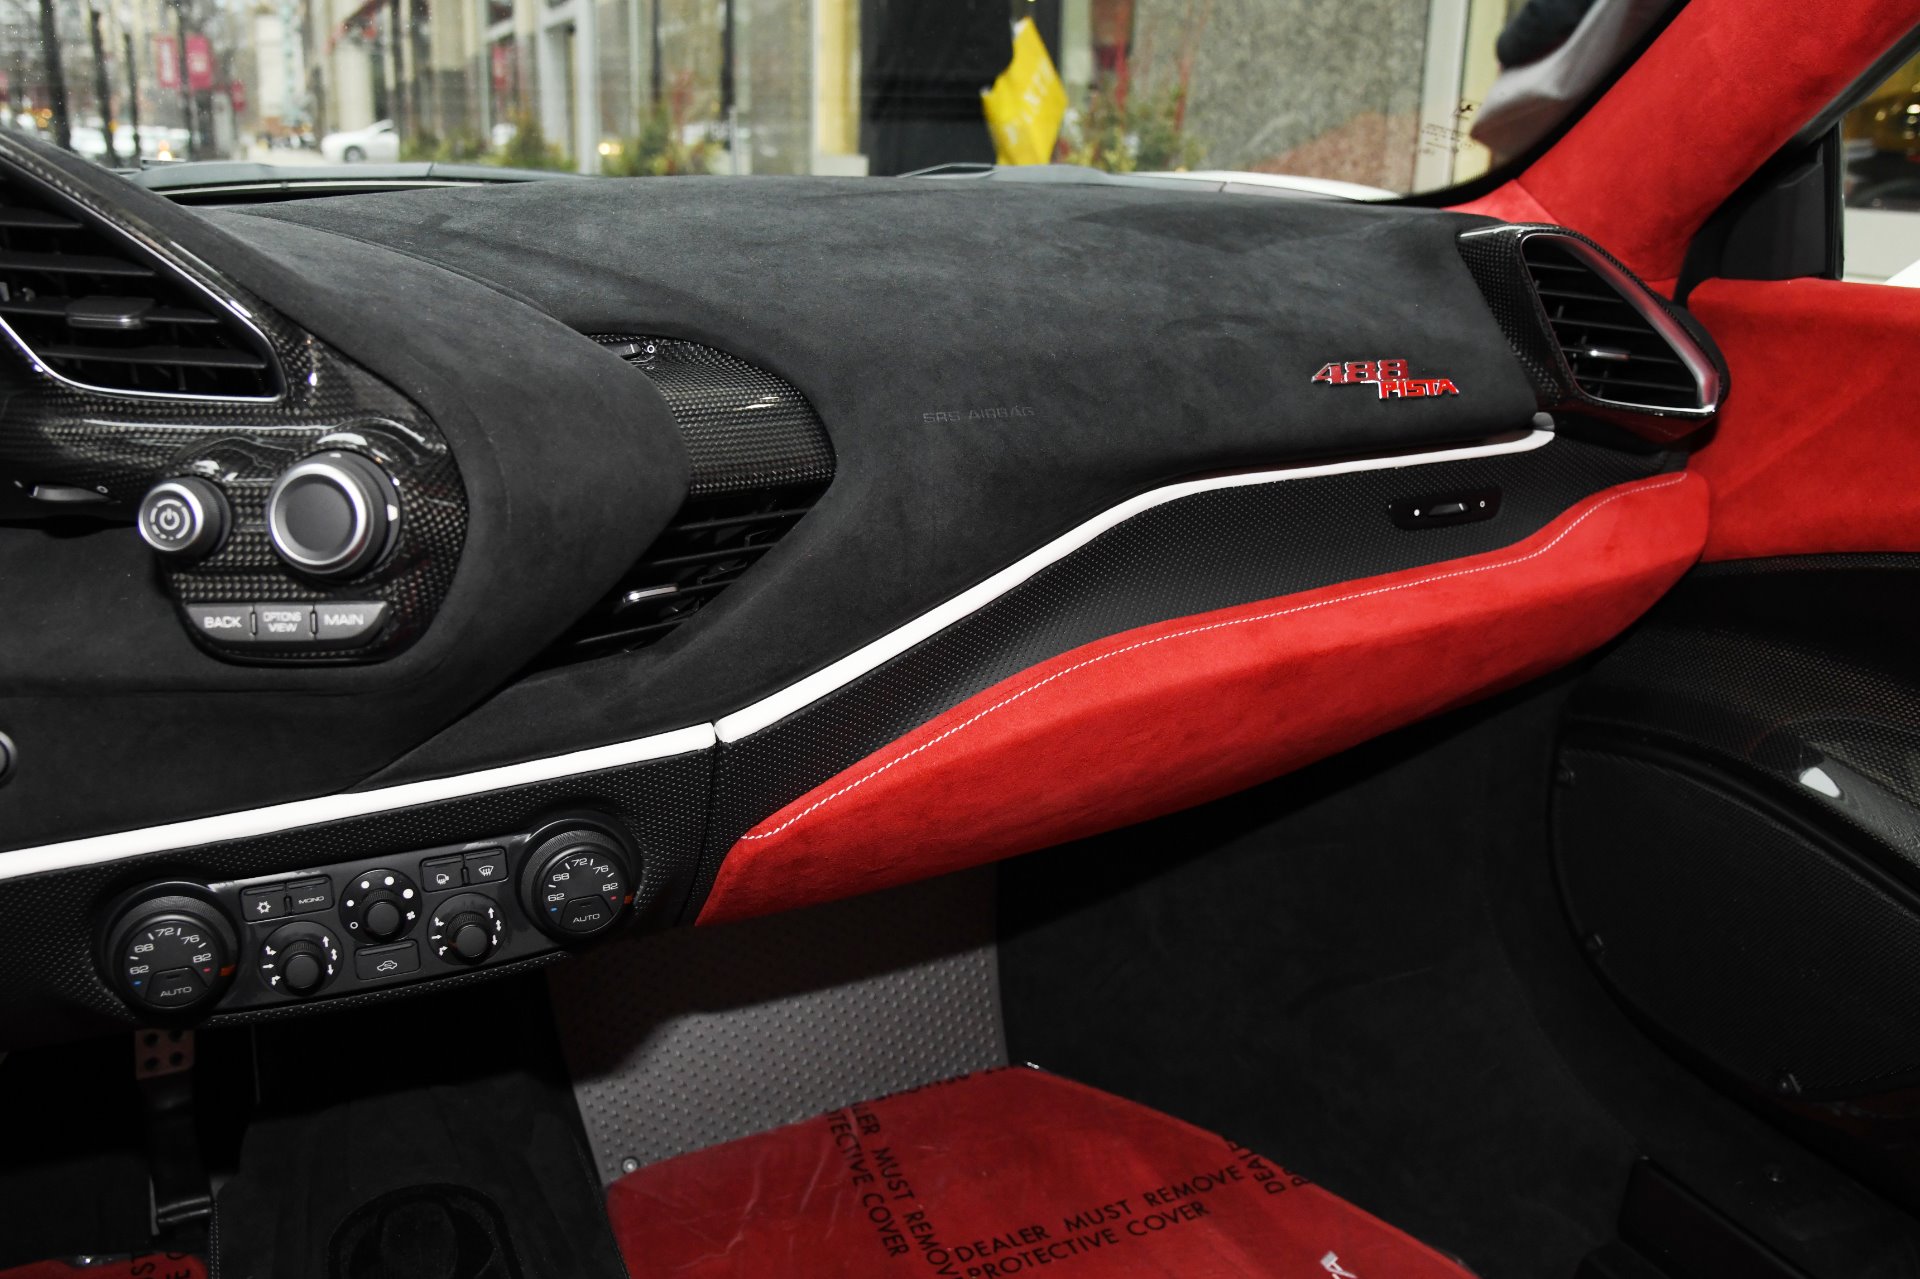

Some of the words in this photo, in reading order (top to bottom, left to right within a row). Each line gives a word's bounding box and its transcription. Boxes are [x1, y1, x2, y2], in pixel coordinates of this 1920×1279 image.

[1311, 359, 1409, 384] 488
[1378, 379, 1460, 399] PISTA
[923, 411, 960, 422] SRS
[968, 406, 1036, 419] AIRBAG
[203, 616, 242, 628] BACK
[323, 614, 364, 625] MAIN
[267, 622, 298, 632] VIEW
[571, 857, 588, 867] 72
[593, 865, 609, 875] 76
[552, 872, 570, 882] 68
[602, 882, 618, 892] 82
[298, 895, 325, 904] MONO
[547, 892, 565, 902] 62
[572, 913, 600, 923] AUTO
[155, 927, 174, 937] 72
[181, 934, 200, 945] 76
[134, 943, 154, 953] 68
[193, 952, 212, 963] 82
[129, 964, 149, 974] 62
[160, 986, 192, 997] AUTO
[826, 1108, 875, 1187] TECTIVE
[862, 1192, 910, 1257] COVER
[872, 1146, 915, 1200] MUST
[903, 1209, 963, 1279] REMOV
[954, 1225, 1051, 1263] DEALER
[1063, 1199, 1133, 1232] MUST
[1143, 1164, 1245, 1207] REMOVE
[967, 1229, 1120, 1279] PROTECTIVE
[1126, 1200, 1212, 1236] COVER
